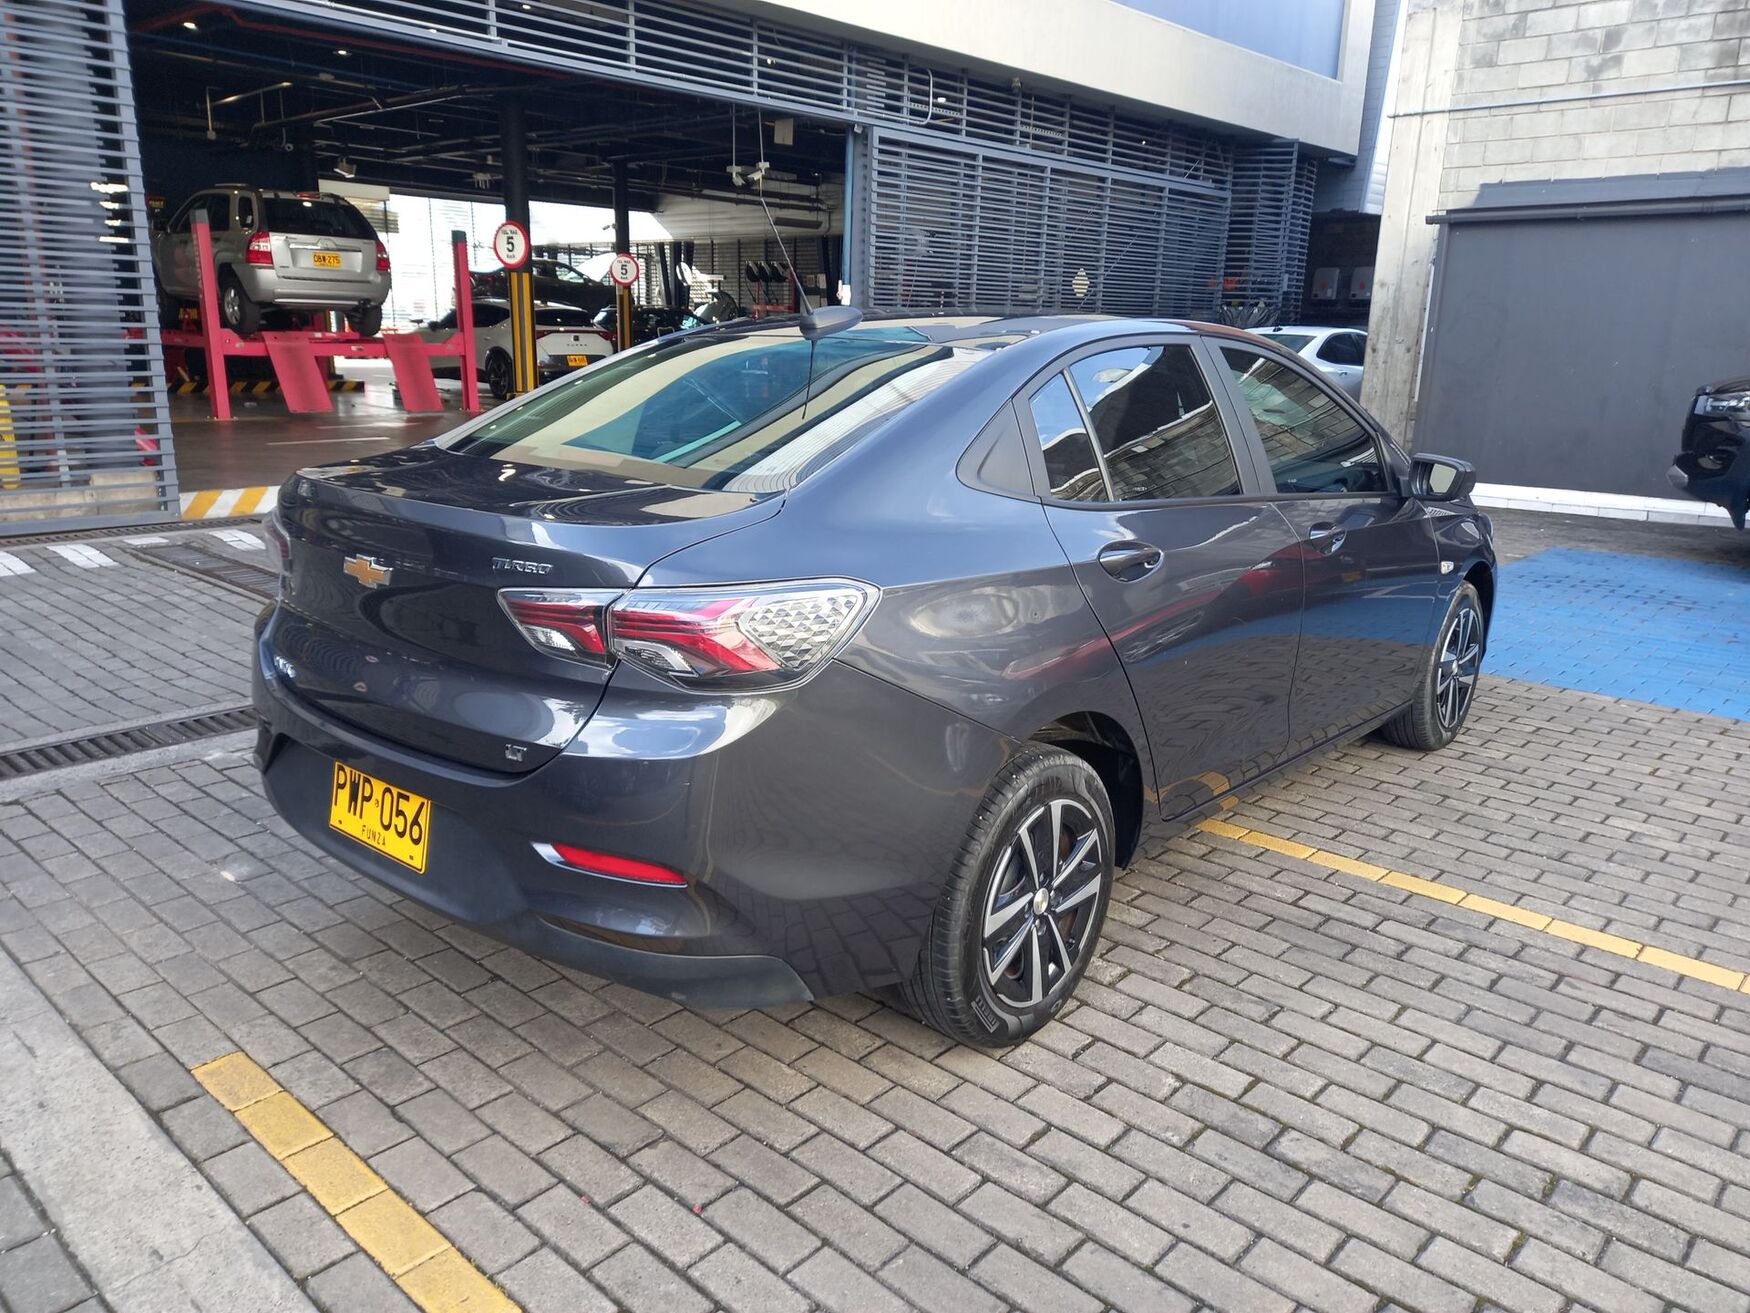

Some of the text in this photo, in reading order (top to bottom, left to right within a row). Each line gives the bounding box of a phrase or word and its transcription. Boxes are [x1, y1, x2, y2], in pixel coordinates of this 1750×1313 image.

[506, 236, 515, 252] 5
[620, 264, 628, 275] 5
[492, 557, 554, 575] TURBO
[505, 743, 528, 762] LT
[334, 763, 425, 846] PWP 056
[361, 824, 387, 846] FUNZA
